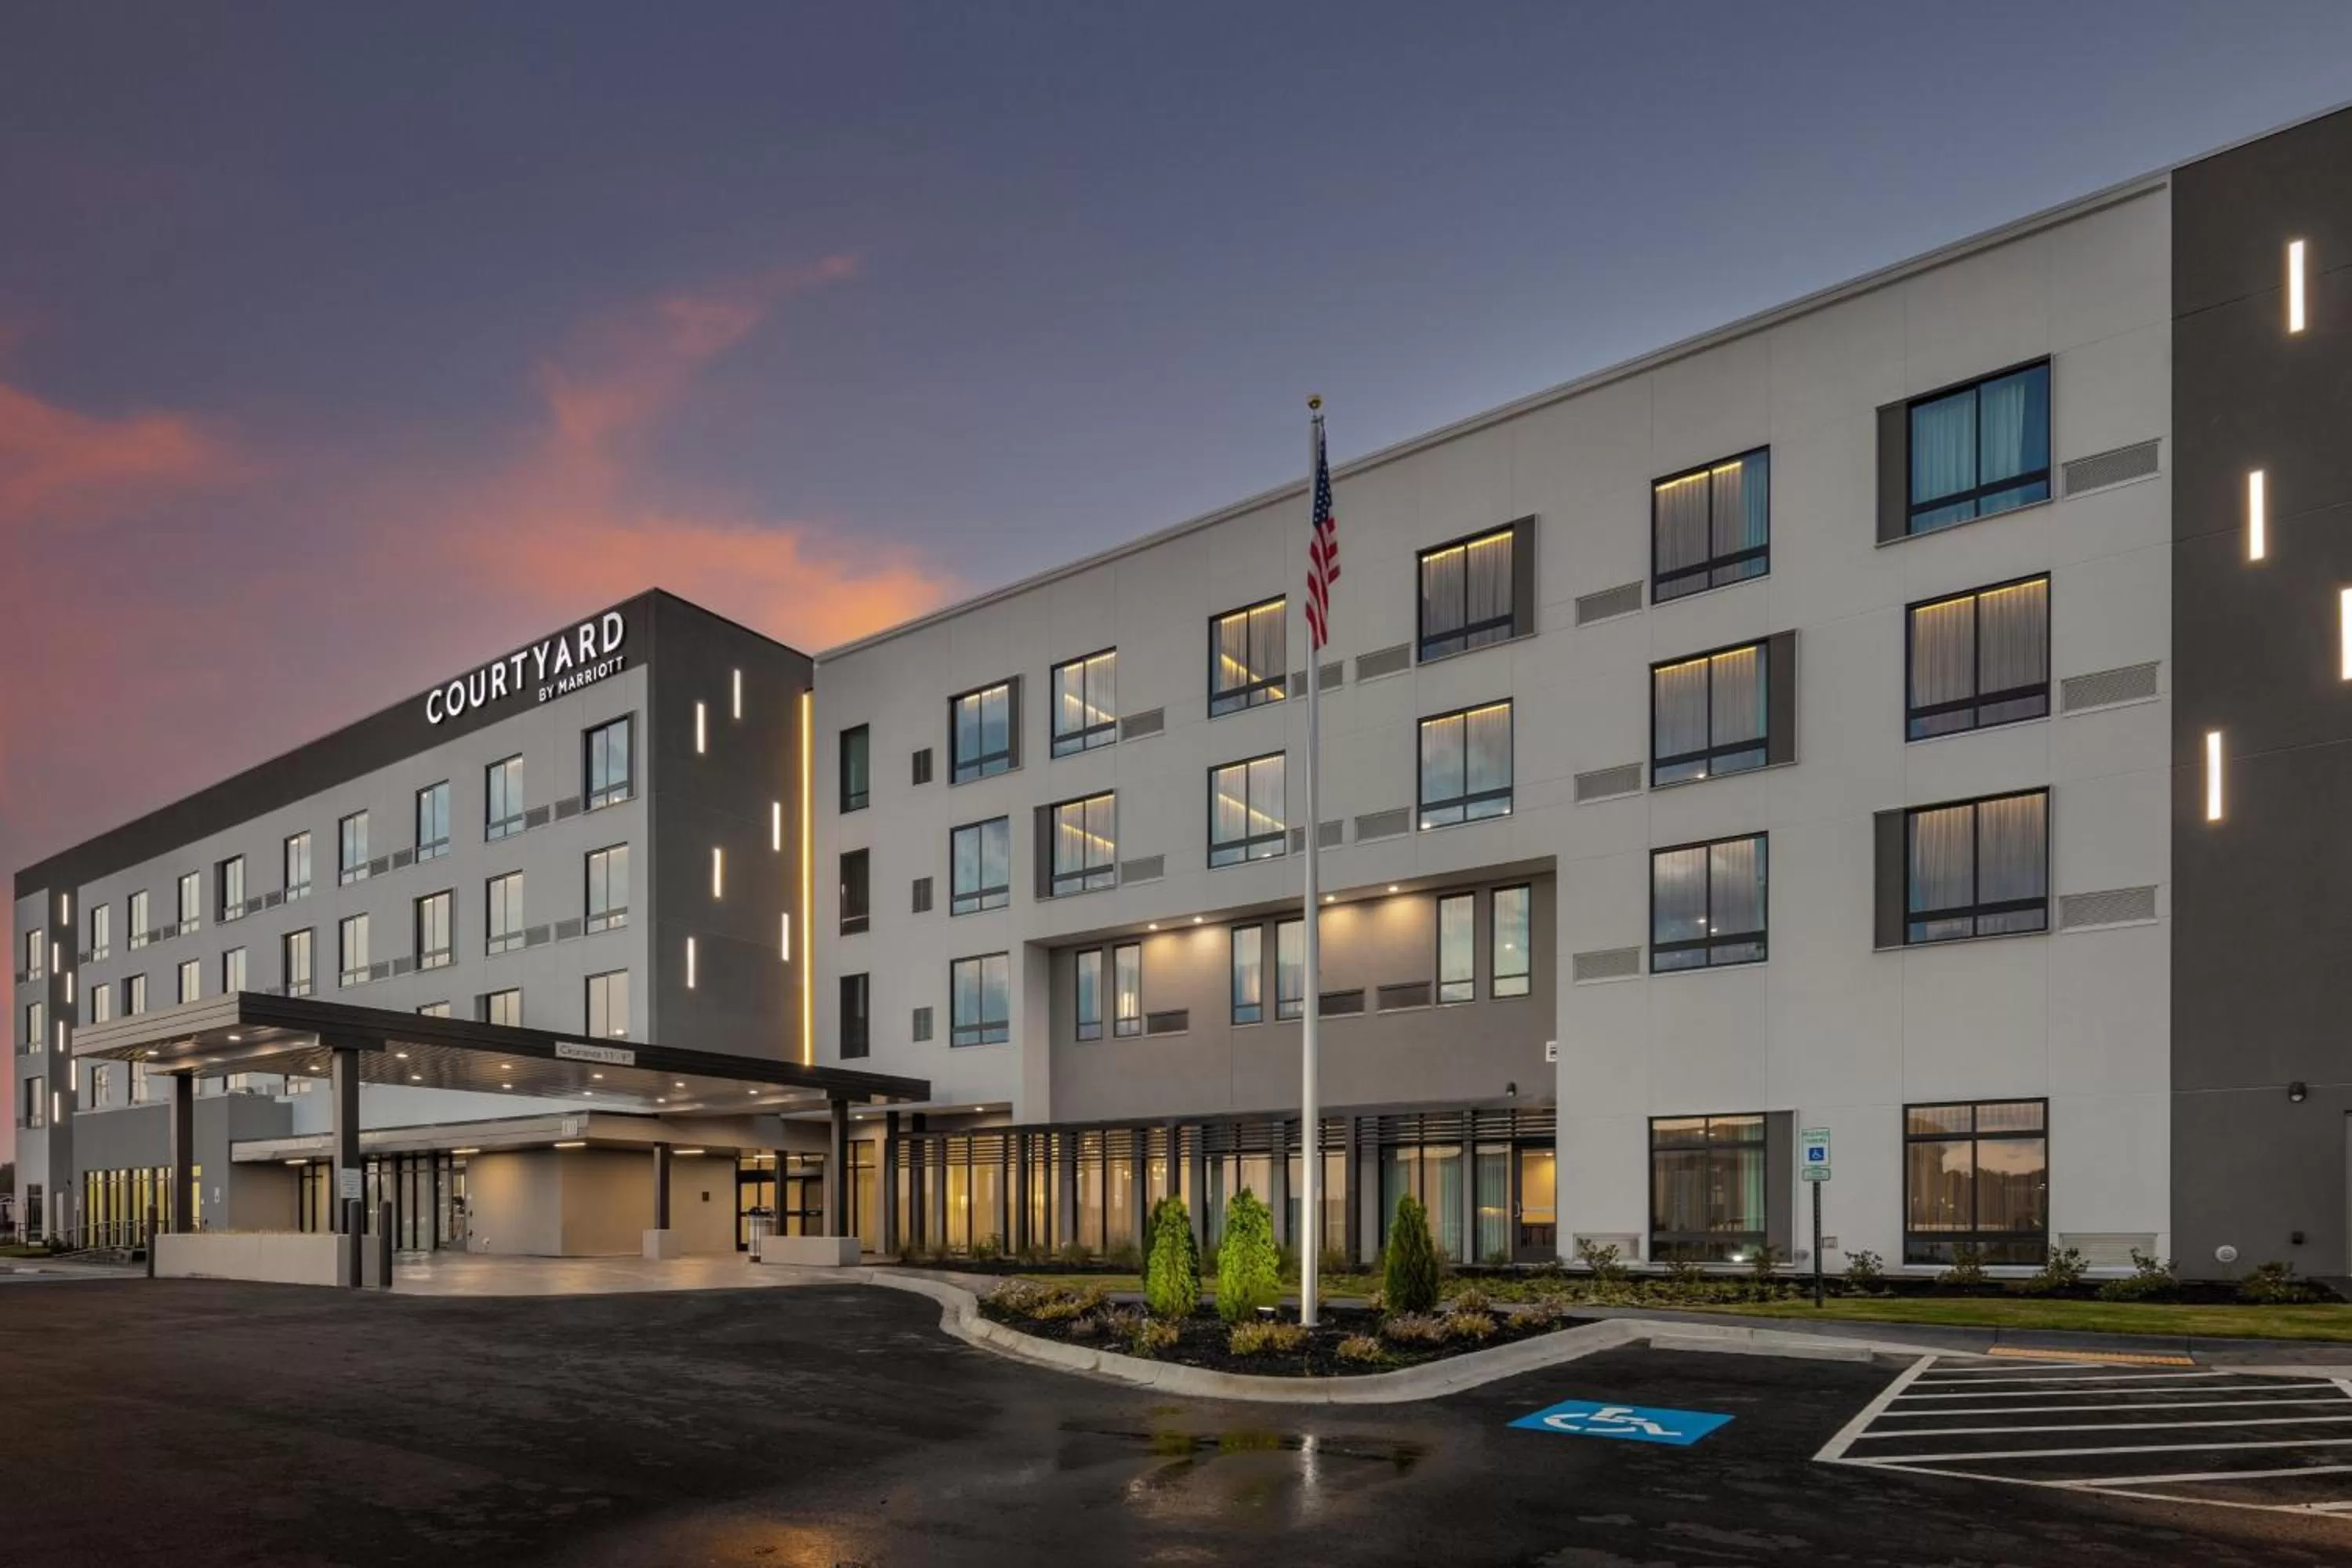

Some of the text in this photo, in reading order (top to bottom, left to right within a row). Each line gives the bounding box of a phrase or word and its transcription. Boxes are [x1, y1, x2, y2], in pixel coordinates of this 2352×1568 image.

[426, 611, 624, 724] COURTYARD
[539, 656, 624, 702] BY MARRIOTT
